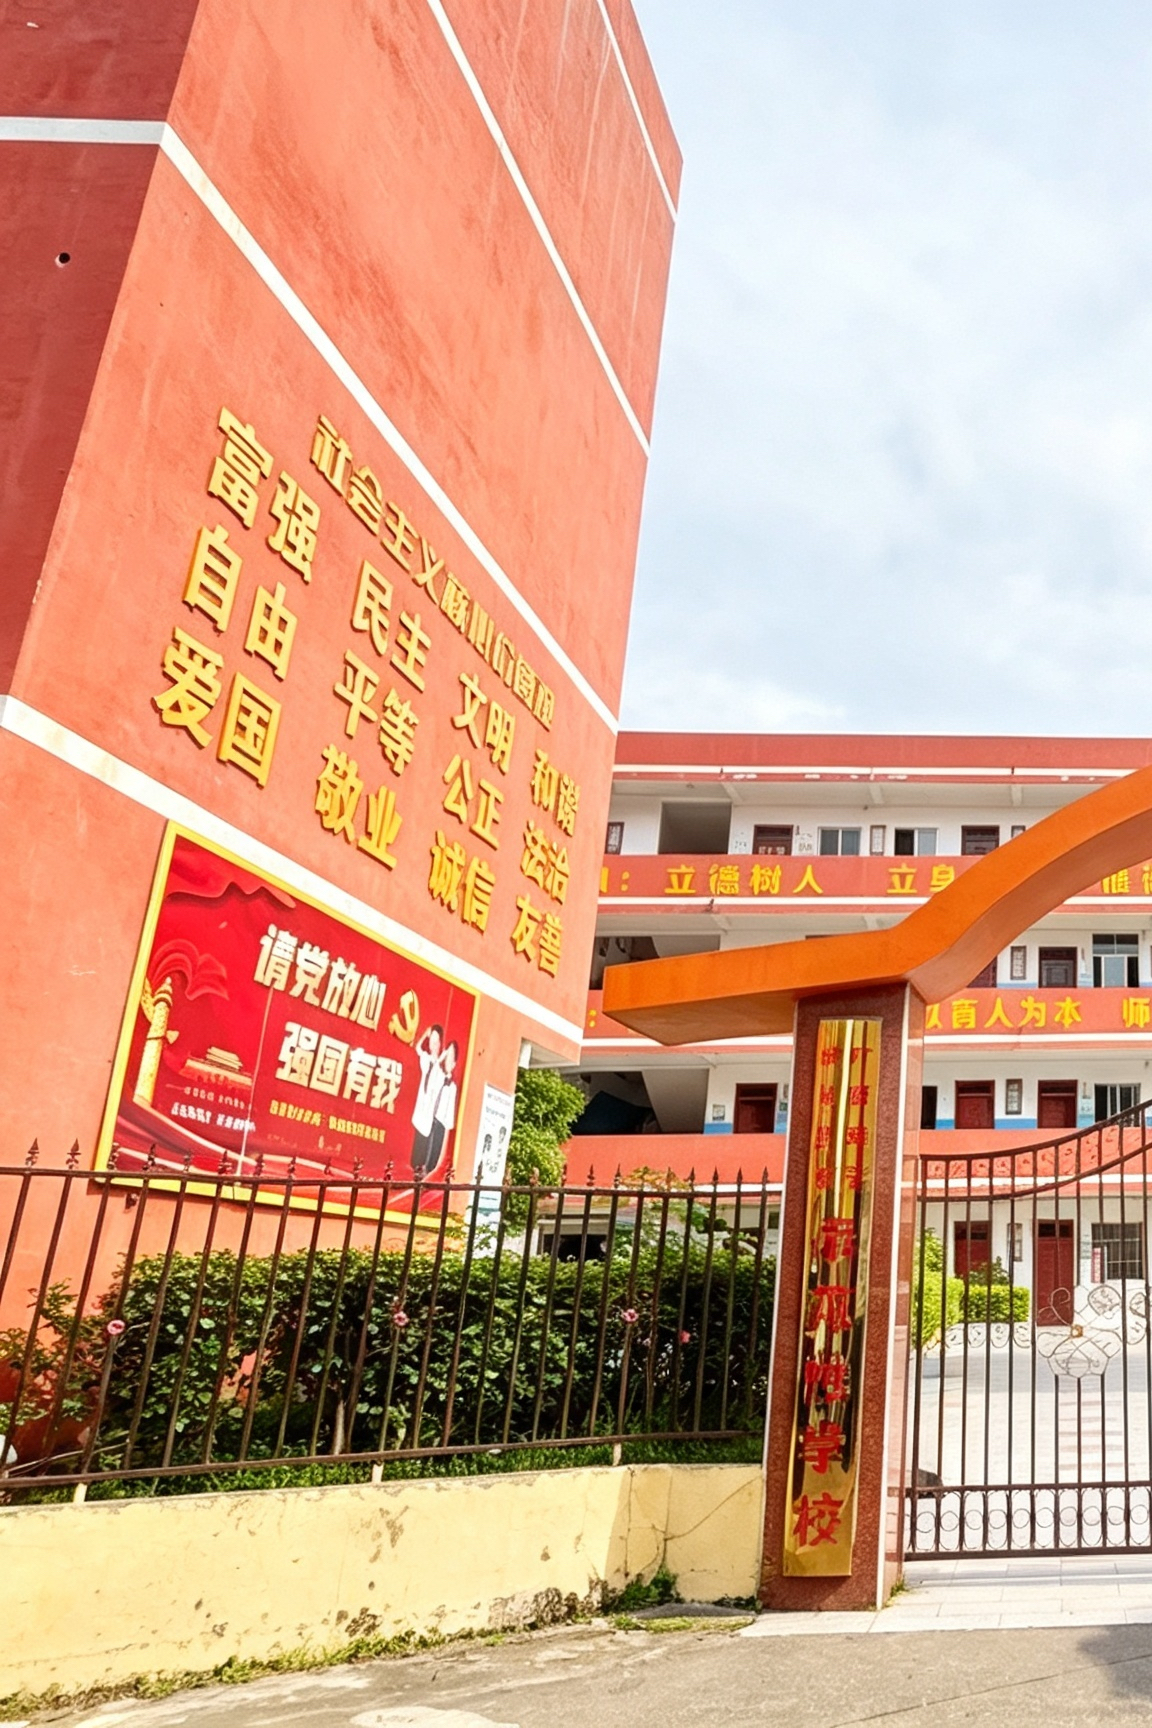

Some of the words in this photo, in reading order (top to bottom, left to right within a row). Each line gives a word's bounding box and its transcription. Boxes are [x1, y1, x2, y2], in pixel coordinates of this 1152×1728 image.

[182, 524, 298, 681] 自由
[335, 649, 420, 776] 平等
[441, 753, 504, 850] 公正
[520, 820, 570, 905] 法治
[207, 406, 321, 583] 富强
[352, 560, 432, 692] 民主
[451, 672, 516, 774] 文明
[532, 748, 580, 837] 和谐
[153, 627, 282, 787] 爱国
[315, 743, 403, 869] 敬业
[429, 830, 496, 935] 诚信
[512, 893, 563, 977] 友善
[664, 863, 824, 896] 立德树人
[254, 923, 386, 1032] 请党放心
[276, 1022, 402, 1114] 强国有我
